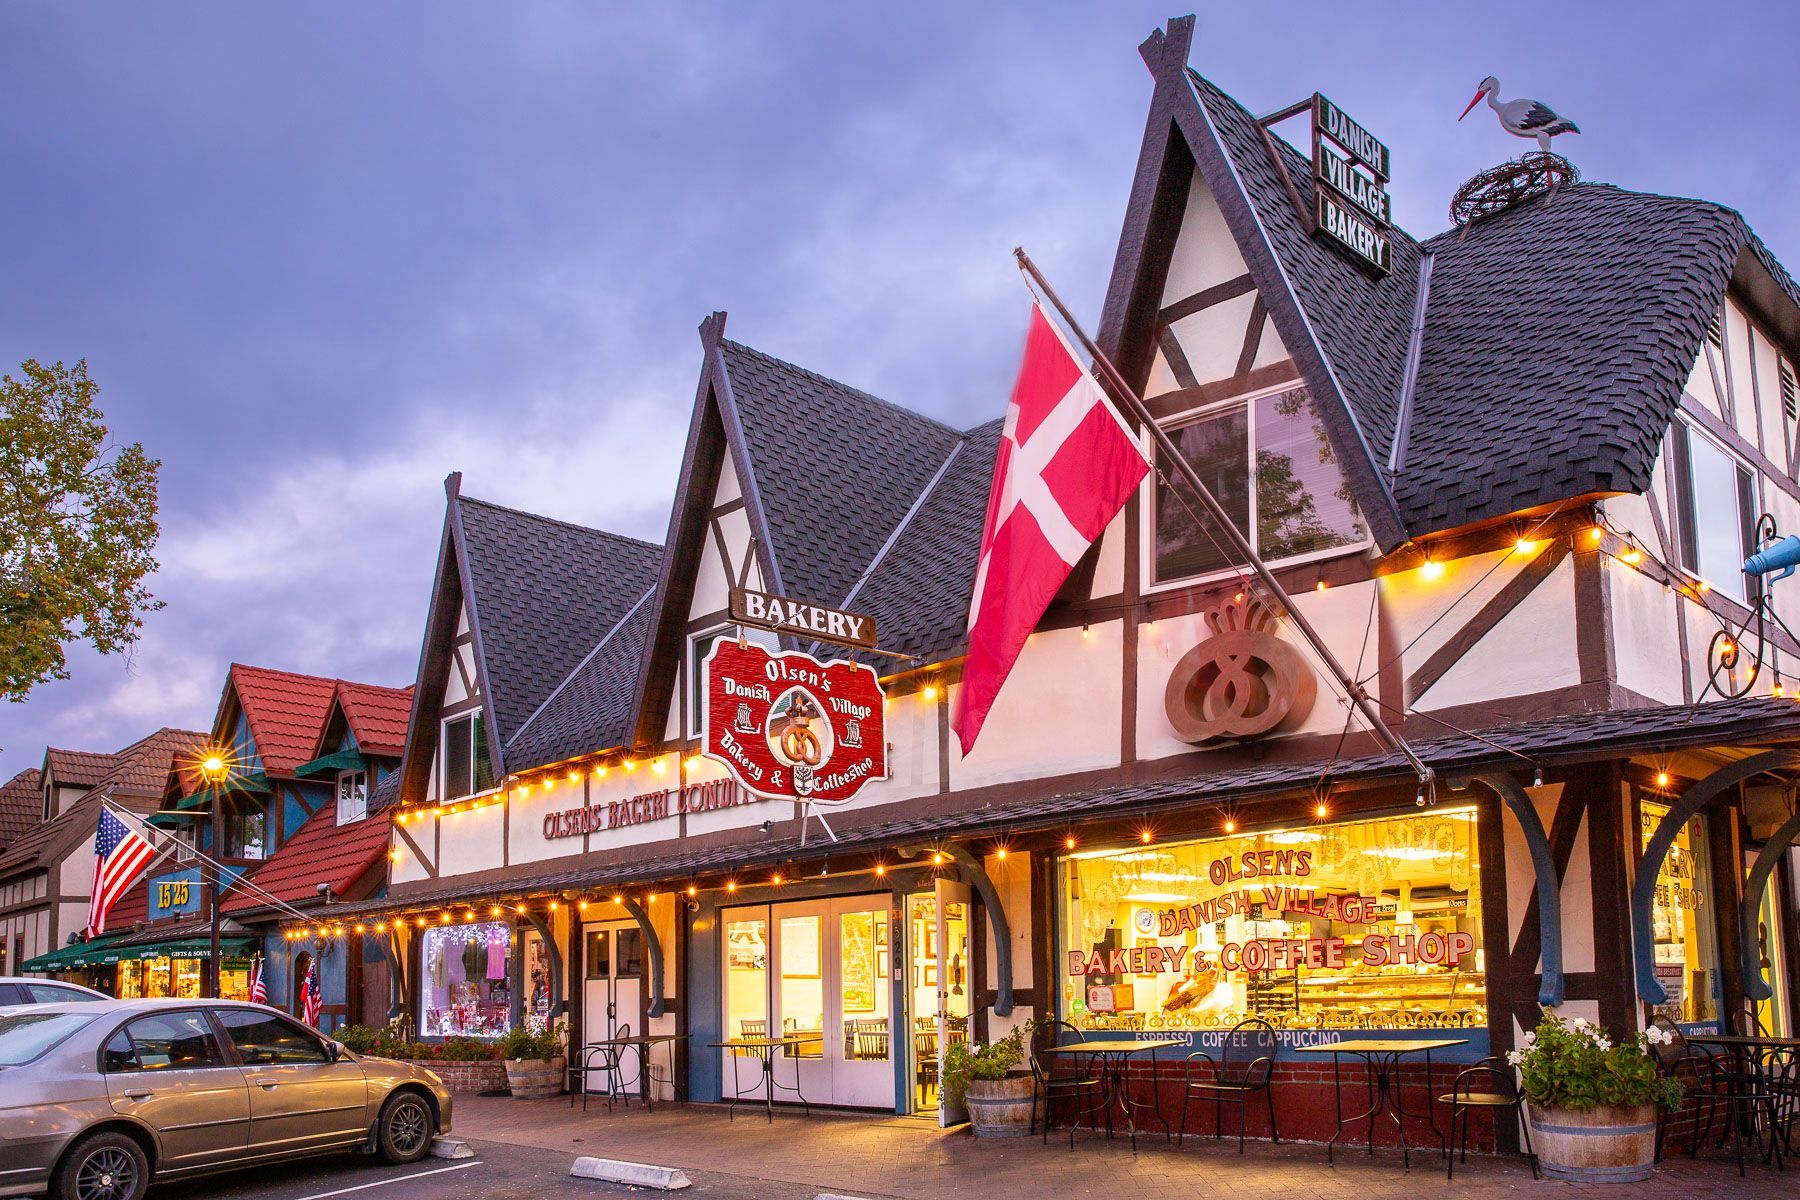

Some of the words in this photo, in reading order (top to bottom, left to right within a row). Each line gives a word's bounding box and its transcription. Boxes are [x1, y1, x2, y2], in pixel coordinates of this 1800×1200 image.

[1327, 101, 1382, 172] DANISH
[1326, 150, 1386, 221] VILLAGE
[1327, 200, 1385, 266] BAKERY
[744, 592, 864, 640] BAKERY
[722, 676, 772, 705] Danish
[765, 660, 832, 692] Olsen's
[829, 696, 872, 721] Village
[720, 728, 763, 781] Bakery
[770, 771, 783, 787] &
[813, 757, 873, 792] Coffeeshop
[543, 804, 601, 840] OLSENS
[677, 777, 757, 813] CONDI
[1209, 849, 1312, 886] OLSEN'S
[1662, 846, 1698, 880] ERY
[1158, 889, 1251, 937] DANISH
[1262, 885, 1379, 925] VILLAGE
[1677, 887, 1704, 911] SHOP
[1068, 945, 1188, 977] BAKERY
[1194, 950, 1211, 972] &
[1221, 938, 1346, 973] COFFEE
[1362, 931, 1474, 967] SHOP
[1135, 1032, 1193, 1047] ESPRESSO
[1202, 1032, 1248, 1047] COFFEE
[1257, 1031, 1341, 1047] CAPPUCCINO
